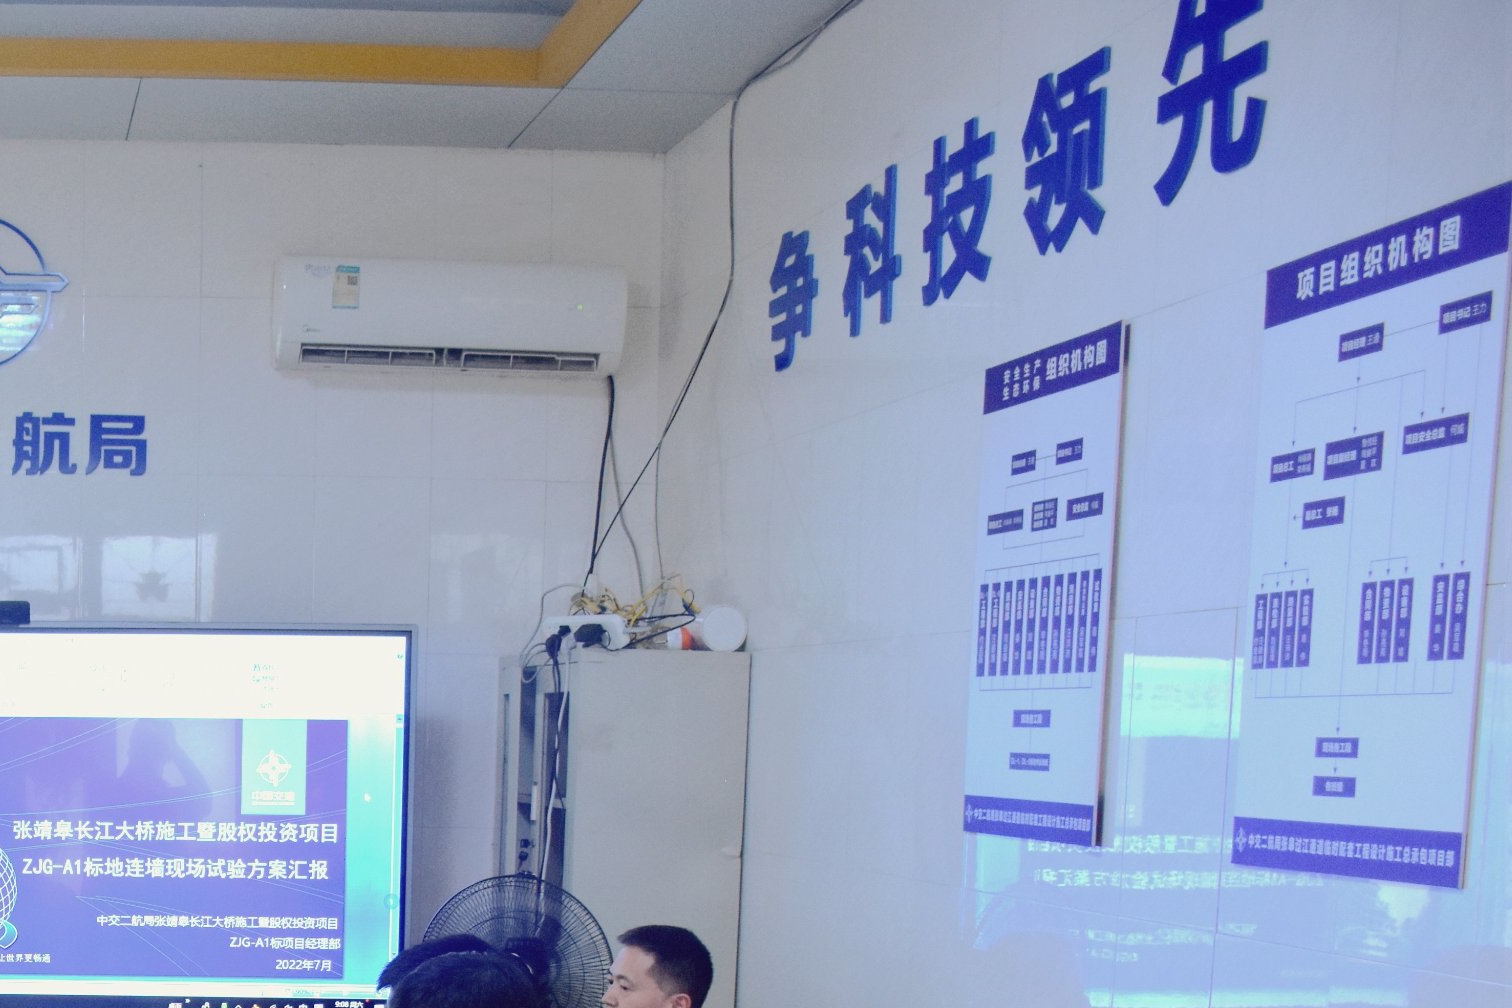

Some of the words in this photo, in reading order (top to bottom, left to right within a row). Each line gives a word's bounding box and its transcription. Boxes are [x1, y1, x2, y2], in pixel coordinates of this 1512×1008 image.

[769, 0, 1269, 372] 争科技领先
[1296, 214, 1461, 301] 项目组织机构图
[1003, 358, 1041, 385] 安全生产
[1045, 339, 1107, 381] 组织机构图
[1002, 376, 1041, 401] 生态环保
[13, 820, 339, 843] 张靖皋长江大桥施工暨股权投资项目
[22, 858, 328, 881] ZJG-A1标地连墙现场试验方案汇报
[229, 937, 342, 950] ZJG-A1标项目经理部
[275, 959, 332, 972] 2022年7月
